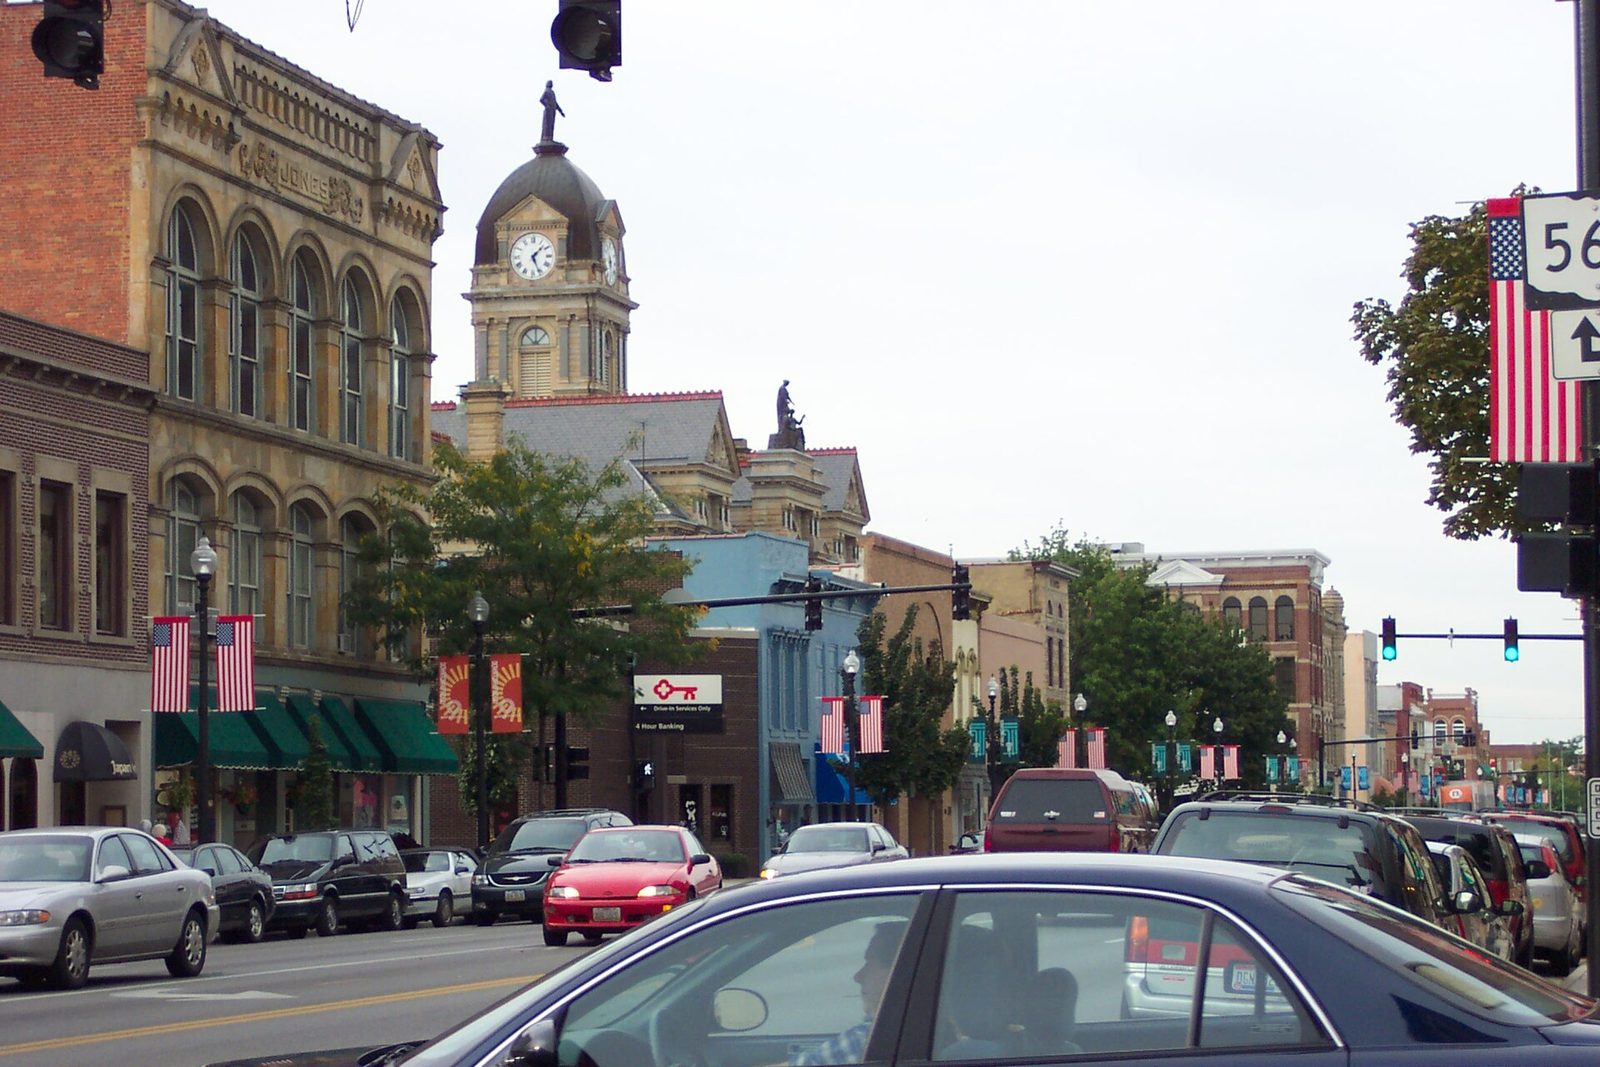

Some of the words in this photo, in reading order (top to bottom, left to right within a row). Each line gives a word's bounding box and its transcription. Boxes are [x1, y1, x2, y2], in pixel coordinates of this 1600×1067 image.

[280, 162, 328, 199] JONES
[1545, 219, 1600, 273] 56
[658, 723, 684, 731] Banking
